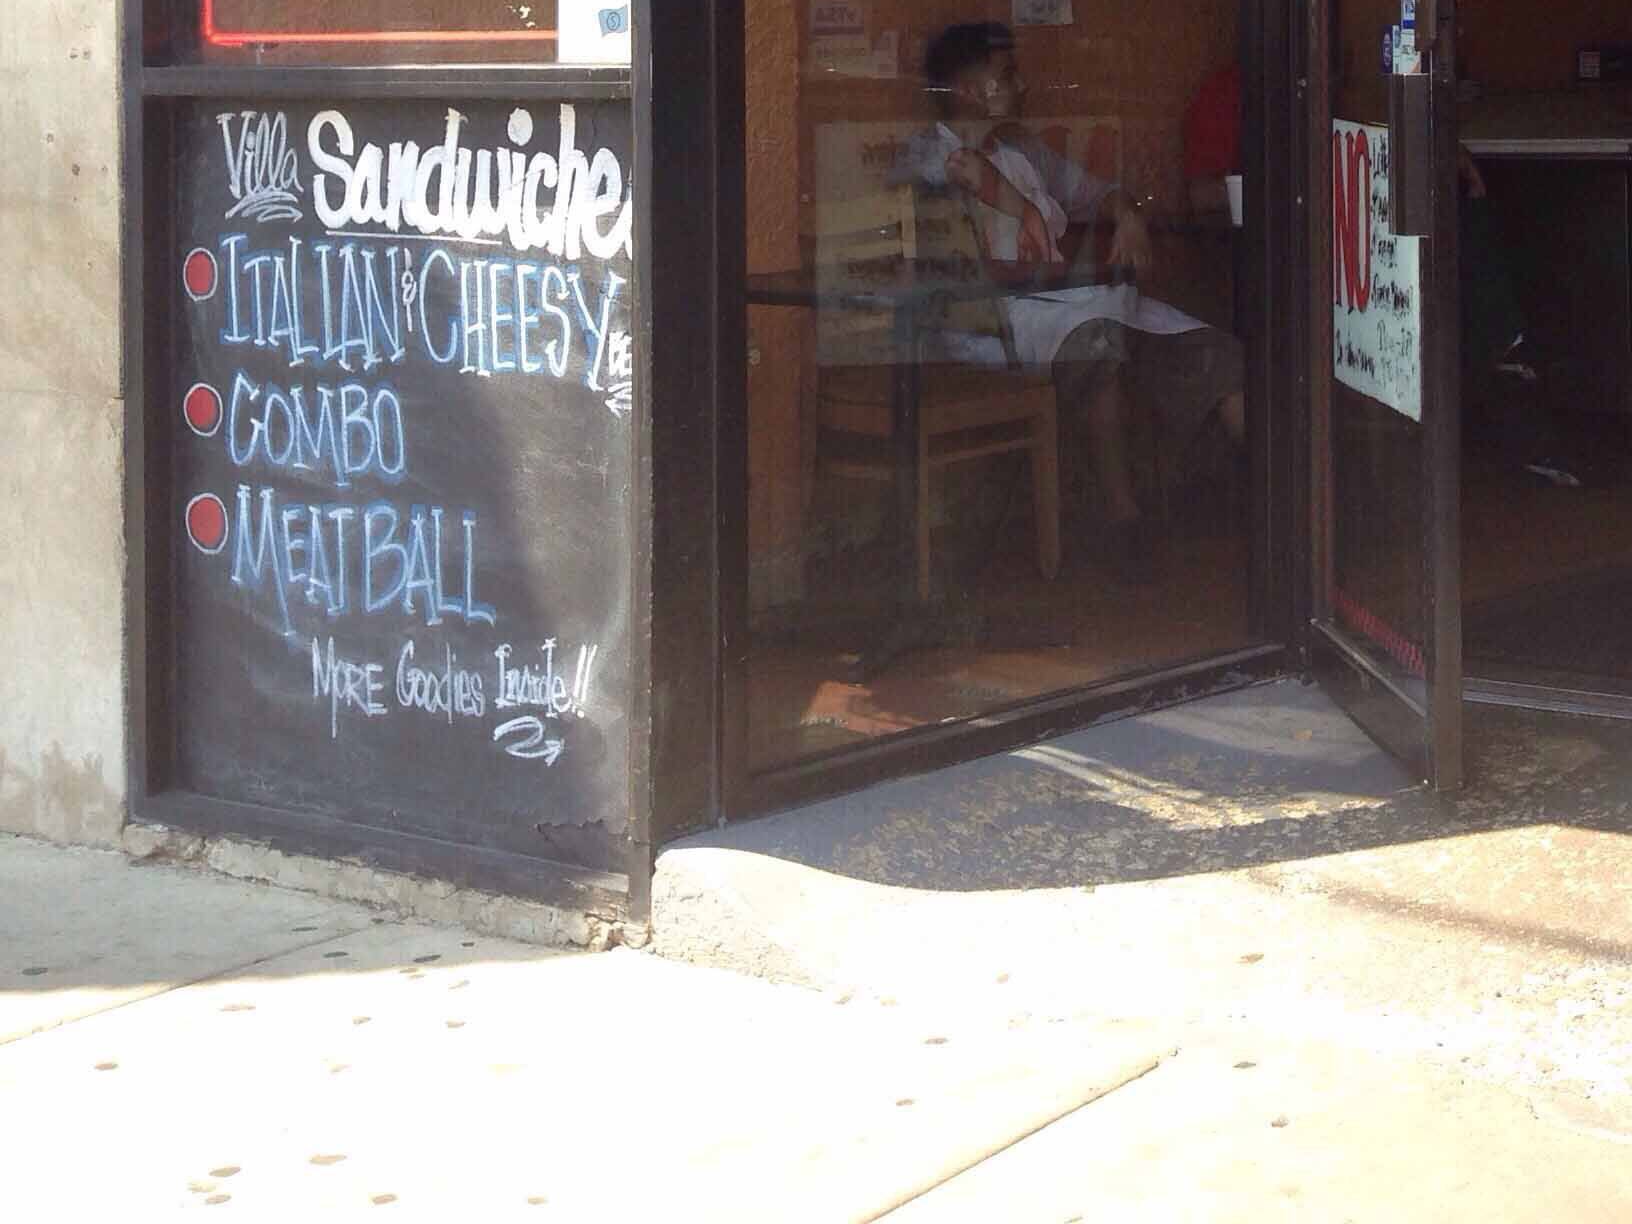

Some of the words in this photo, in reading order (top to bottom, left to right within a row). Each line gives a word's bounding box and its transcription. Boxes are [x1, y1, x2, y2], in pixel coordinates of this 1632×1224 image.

[1333, 129, 1370, 312] NO
[220, 235, 406, 373] ITALIAN
[418, 246, 627, 393] CHEESY
[311, 636, 389, 739] MORE
